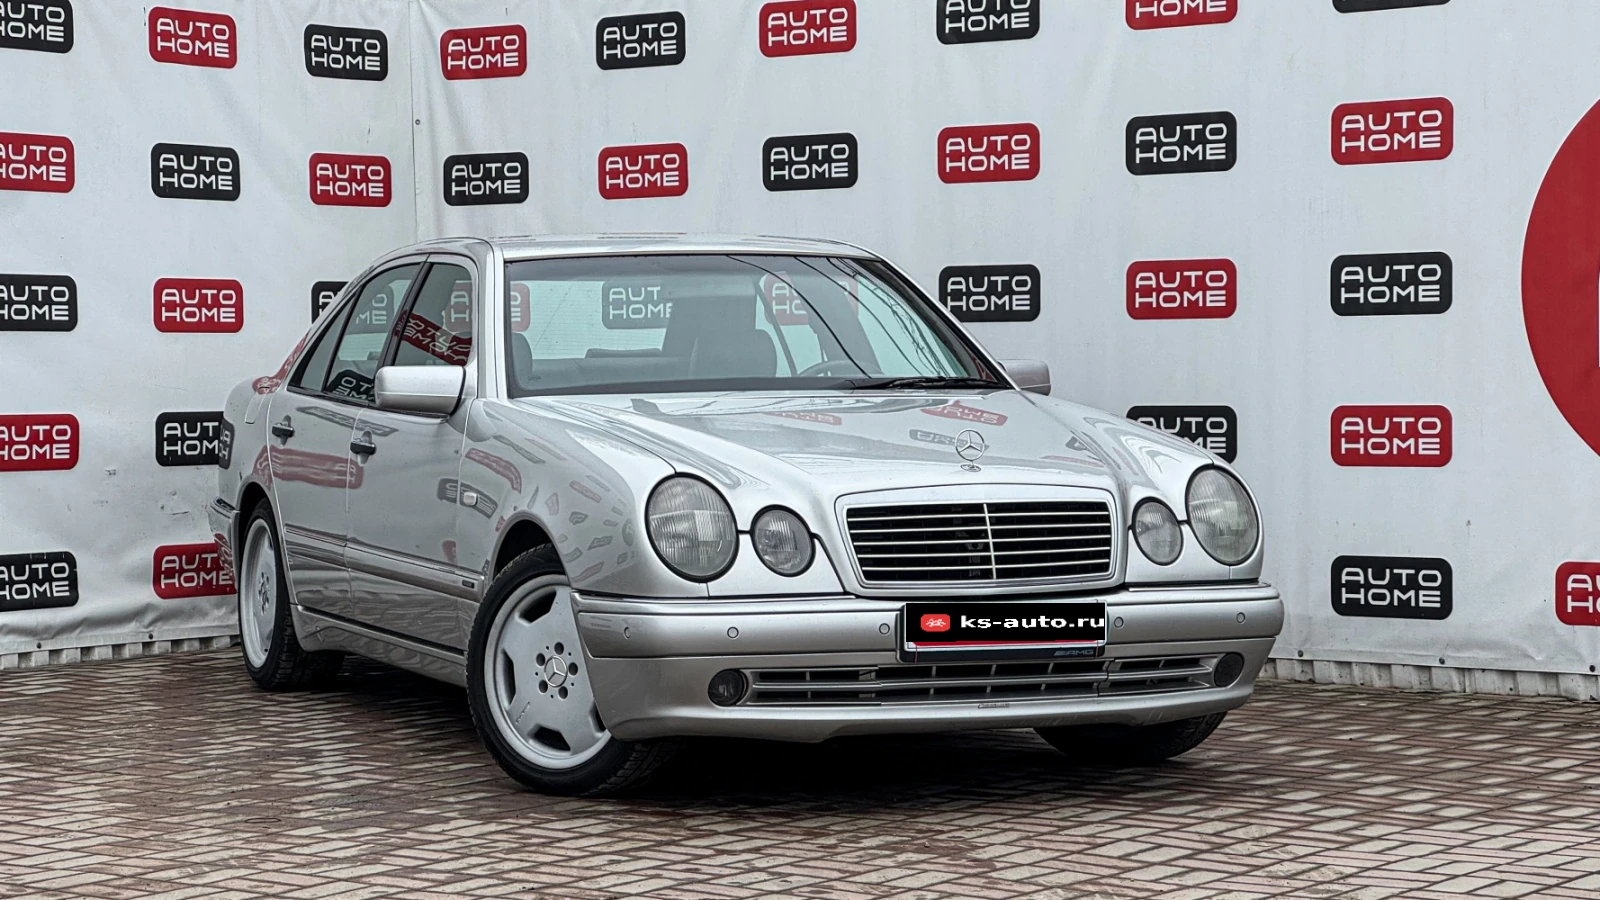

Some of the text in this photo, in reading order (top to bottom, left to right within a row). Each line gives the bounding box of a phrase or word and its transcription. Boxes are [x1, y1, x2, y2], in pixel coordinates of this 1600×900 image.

[0, 1, 66, 23] UTO
[767, 7, 849, 29] AUTO
[1135, 0, 1228, 19] HOME
[0, 20, 65, 43] OME
[156, 17, 230, 41] AUTO
[603, 21, 678, 43] AUTO
[945, 11, 1030, 34] HOME
[310, 34, 381, 54] AUTO
[447, 34, 520, 54] AUTO
[767, 25, 848, 47] HOME
[157, 35, 230, 59] HOME
[603, 39, 677, 60] HOME
[310, 51, 381, 71] HOME
[447, 51, 519, 70] HOME
[1341, 109, 1443, 133] AUTO
[1135, 122, 1228, 145] AUTO
[1341, 130, 1441, 153] HOME
[770, 143, 850, 163] AUTO
[945, 134, 1031, 154] AUTO
[1135, 142, 1226, 164] HOME
[159, 153, 233, 173] AUTO
[316, 163, 384, 180] AUTO
[451, 162, 522, 179] AUTO
[605, 153, 680, 172] AUTO
[770, 161, 849, 181] HOME
[945, 153, 1030, 173] HOME
[159, 171, 233, 191] HOME
[316, 180, 384, 197] HOME
[451, 179, 521, 196] HOME
[605, 170, 680, 190] HOME
[1135, 270, 1228, 289] AUTO
[1340, 263, 1442, 284] AUTO
[608, 286, 661, 302] AUT
[947, 275, 1032, 293] AUTO
[1340, 284, 1441, 304] HOME
[161, 288, 237, 305] AUTO
[947, 294, 1031, 312] HOME
[1135, 289, 1227, 309] HOME
[161, 306, 236, 323] HOME
[163, 421, 219, 438] AUT
[1340, 417, 1442, 435] AUTO
[163, 439, 219, 456] HOM
[1341, 437, 1441, 455] HOME
[161, 553, 218, 571] AUT
[1341, 567, 1442, 587] AUTO
[1567, 574, 1600, 592] A
[1341, 587, 1441, 608] HOME
[1567, 595, 1600, 614] H
